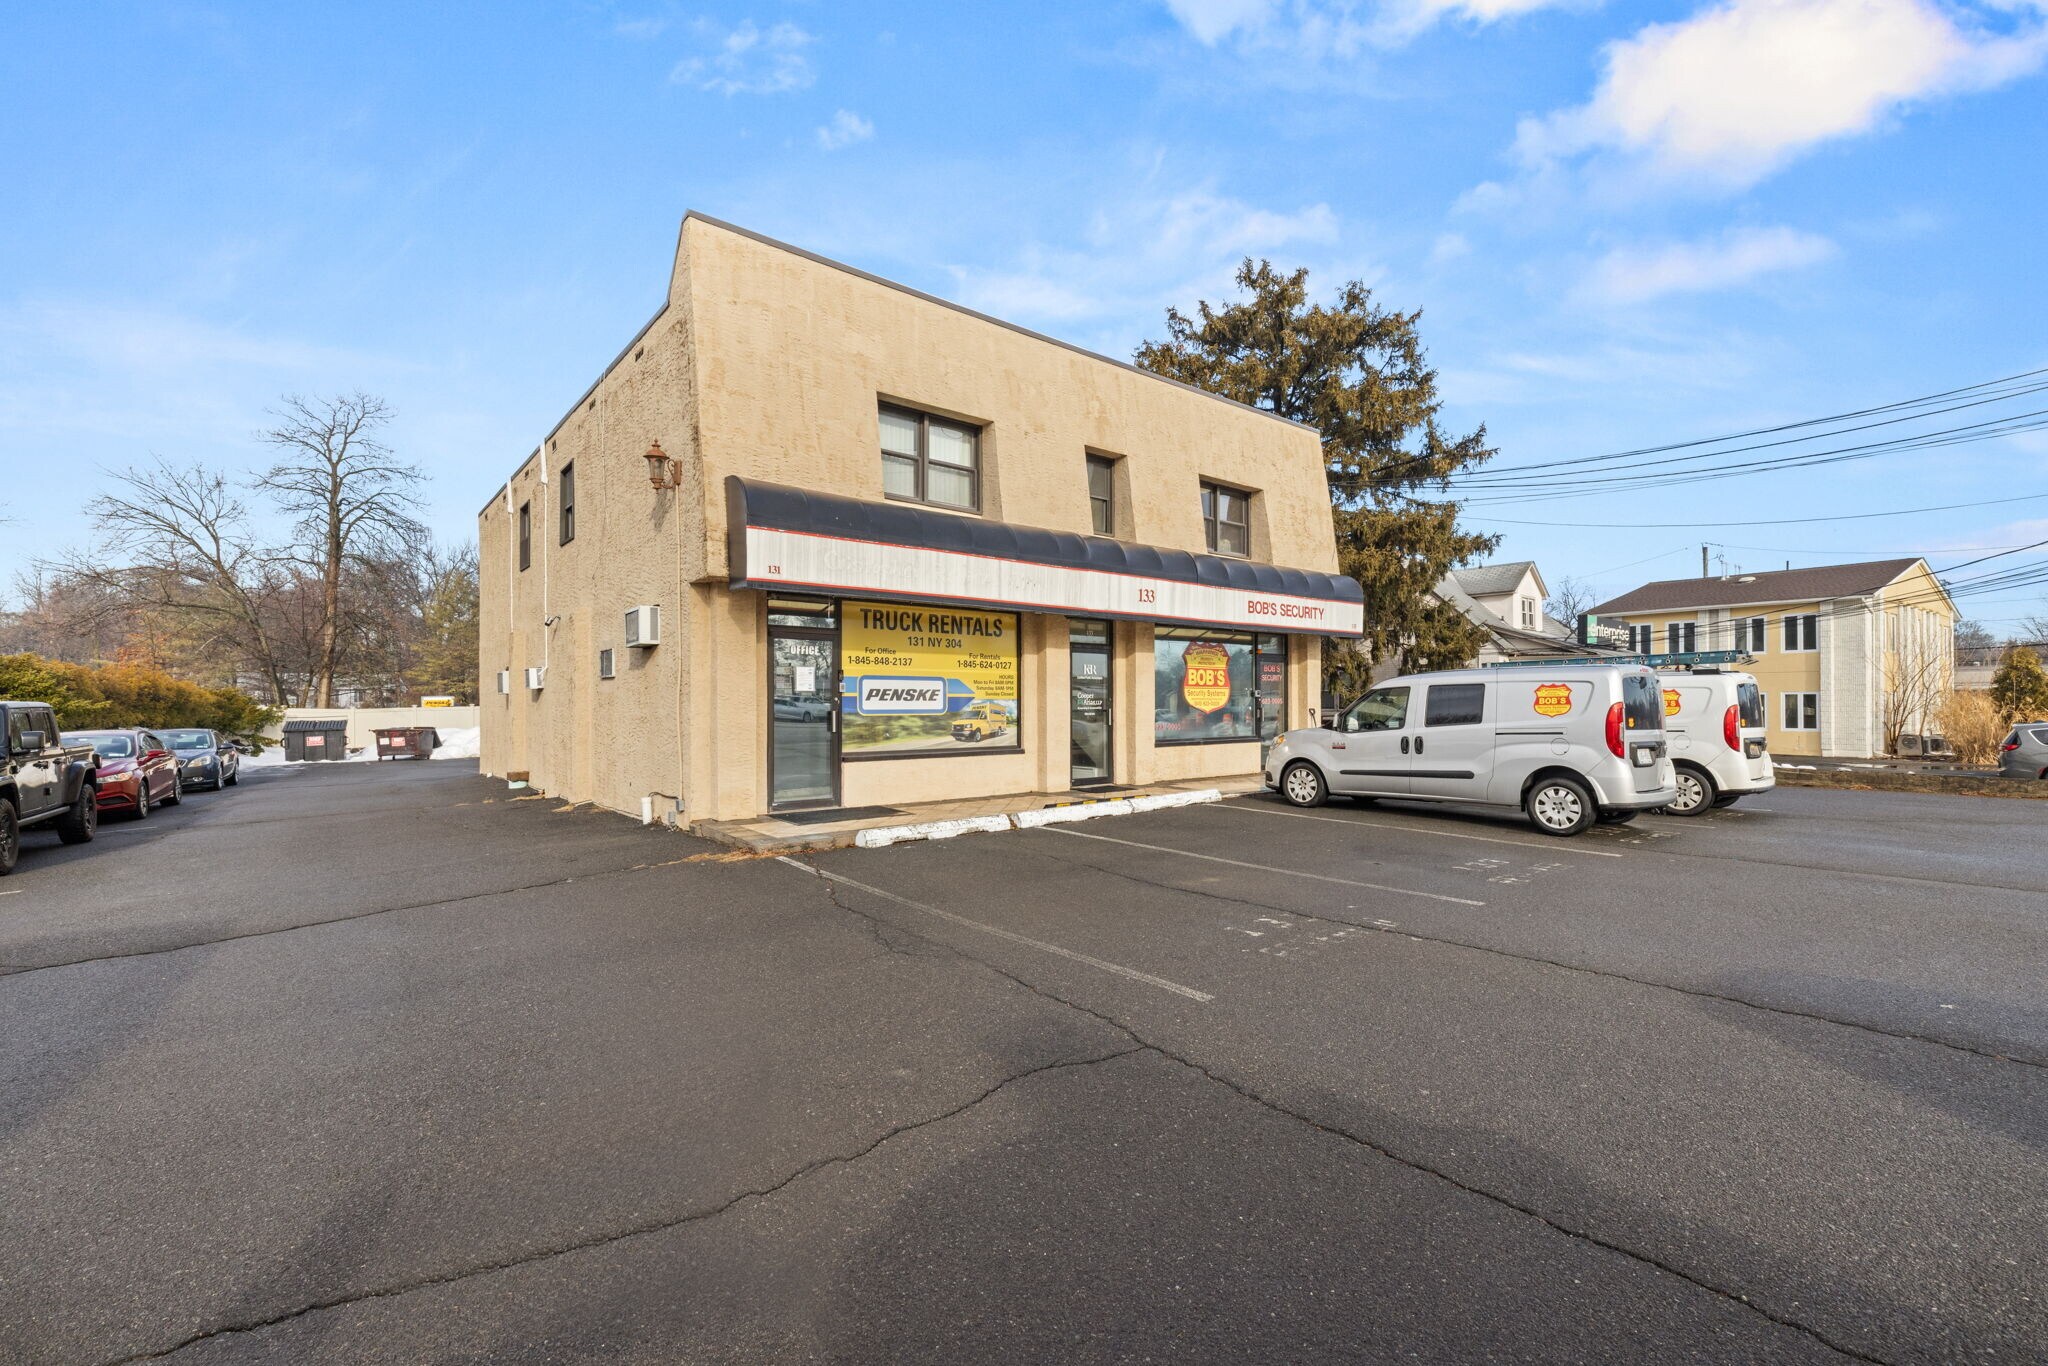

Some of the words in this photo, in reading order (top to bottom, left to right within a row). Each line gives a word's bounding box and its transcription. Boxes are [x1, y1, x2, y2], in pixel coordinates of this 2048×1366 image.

[768, 566, 780, 574] 131
[1138, 588, 1154, 602] 133
[1248, 600, 1277, 616] BOB'S
[1280, 604, 1324, 620] SECURITY
[860, 608, 923, 632] TRUCK
[928, 614, 1002, 637] RENTALS
[1591, 624, 1630, 642] enterprise
[908, 636, 924, 646] 131
[928, 637, 942, 648] NY
[946, 638, 962, 648] 304
[790, 645, 820, 656] OFFICE
[848, 656, 912, 666] 1-845-848-2137
[957, 660, 1012, 669] 1-845-624-0127
[1188, 669, 1225, 686] BOB'S
[866, 688, 940, 701] PENSKE
